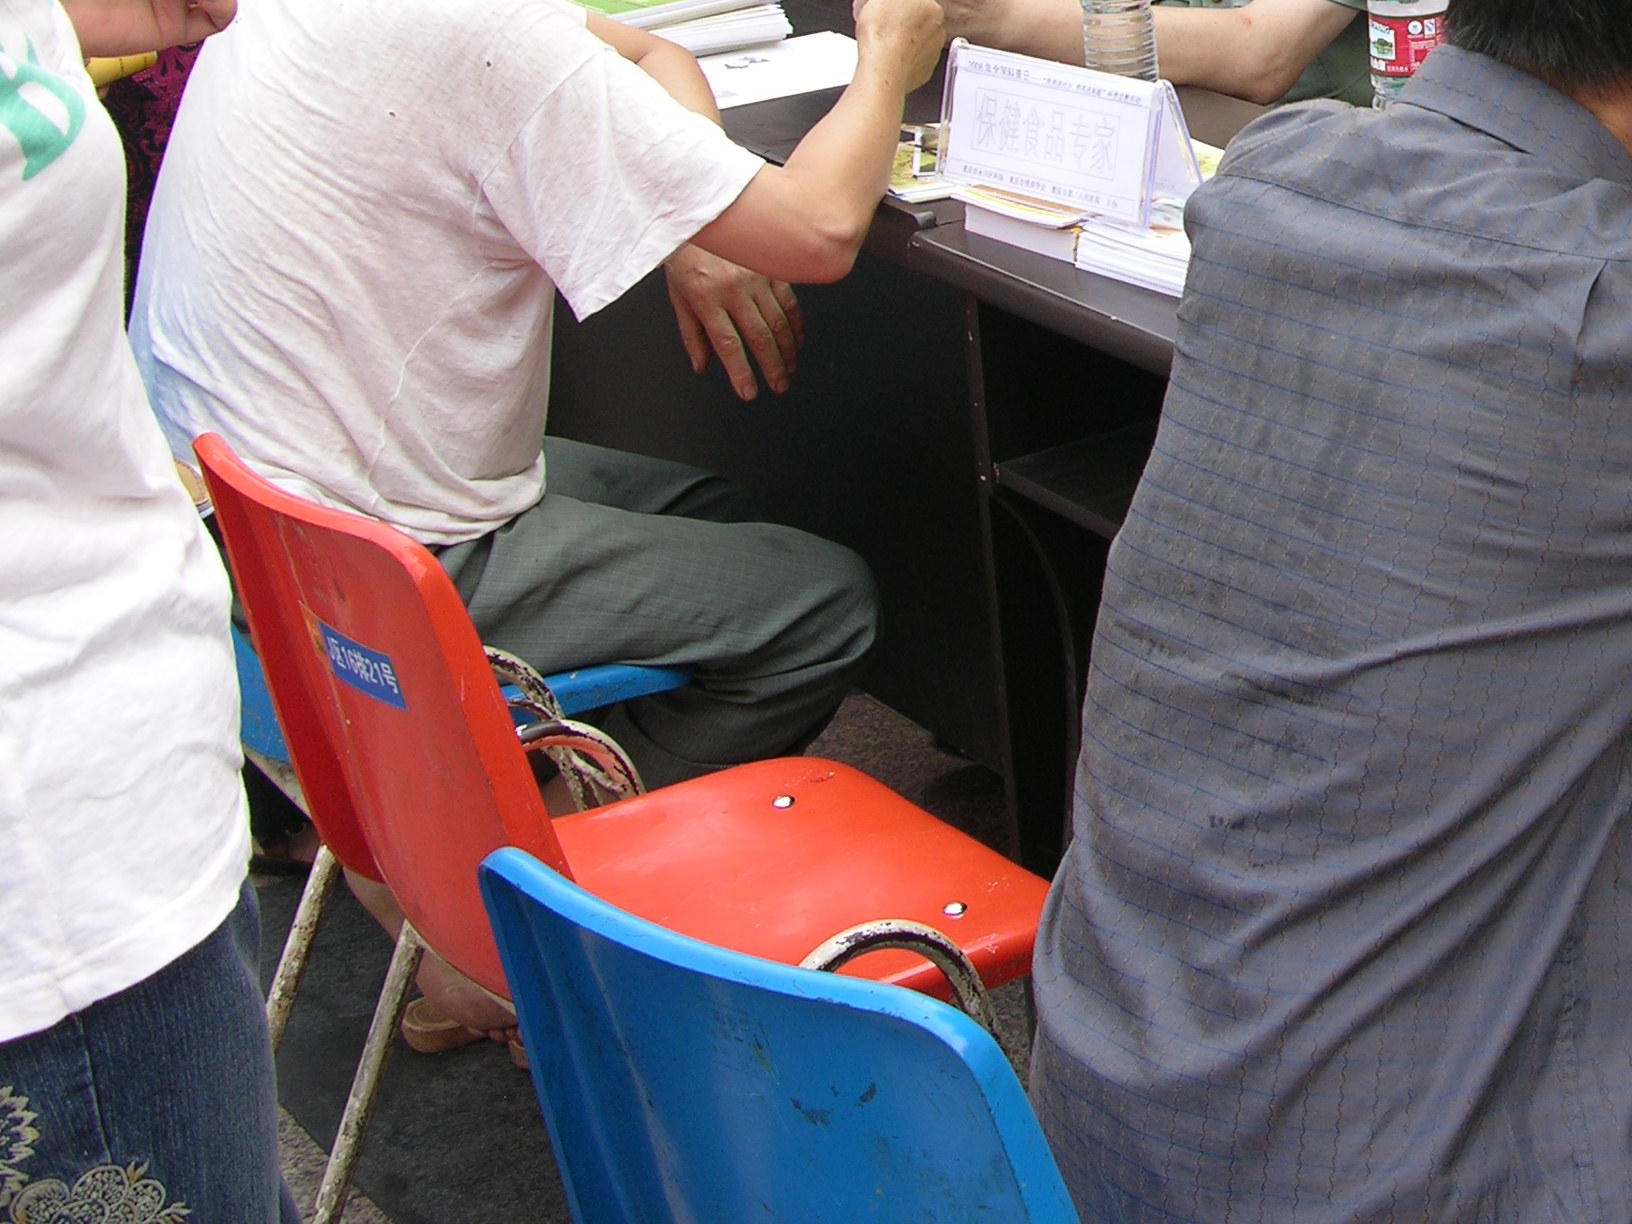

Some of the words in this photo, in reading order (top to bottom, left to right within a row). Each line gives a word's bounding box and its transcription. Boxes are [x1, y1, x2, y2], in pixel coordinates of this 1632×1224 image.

[977, 93, 1116, 172] 保健食品专家
